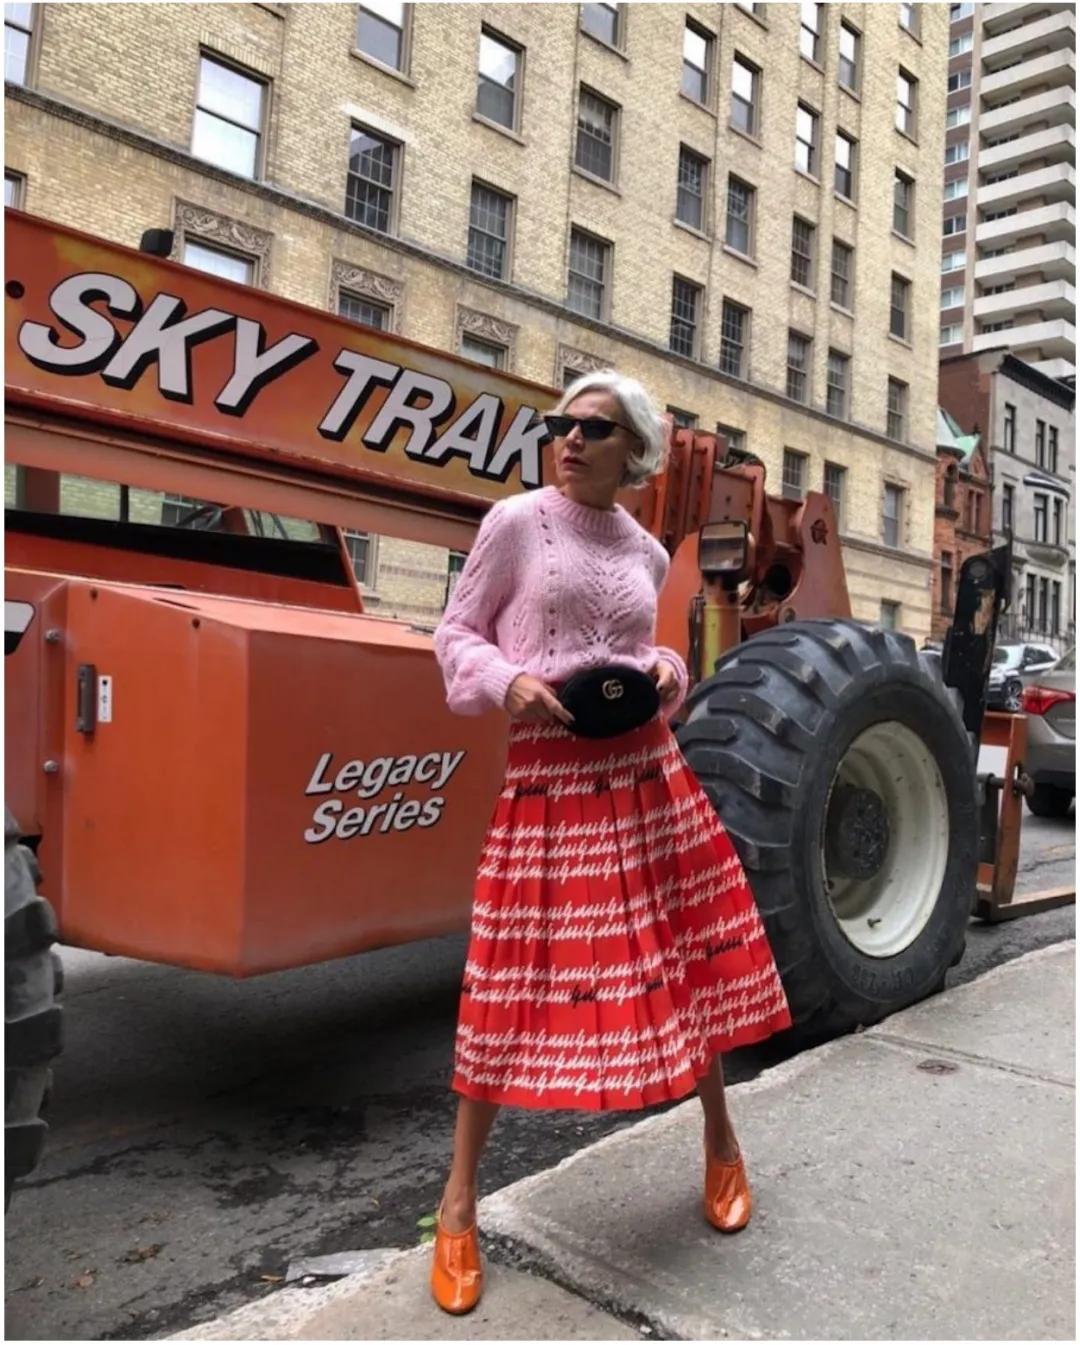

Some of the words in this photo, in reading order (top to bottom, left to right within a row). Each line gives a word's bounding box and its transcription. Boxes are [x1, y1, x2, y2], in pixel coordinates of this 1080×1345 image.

[17, 271, 320, 417] SKY
[317, 347, 554, 489] TRAK
[304, 750, 467, 799] Legacy
[303, 792, 446, 845] Series
